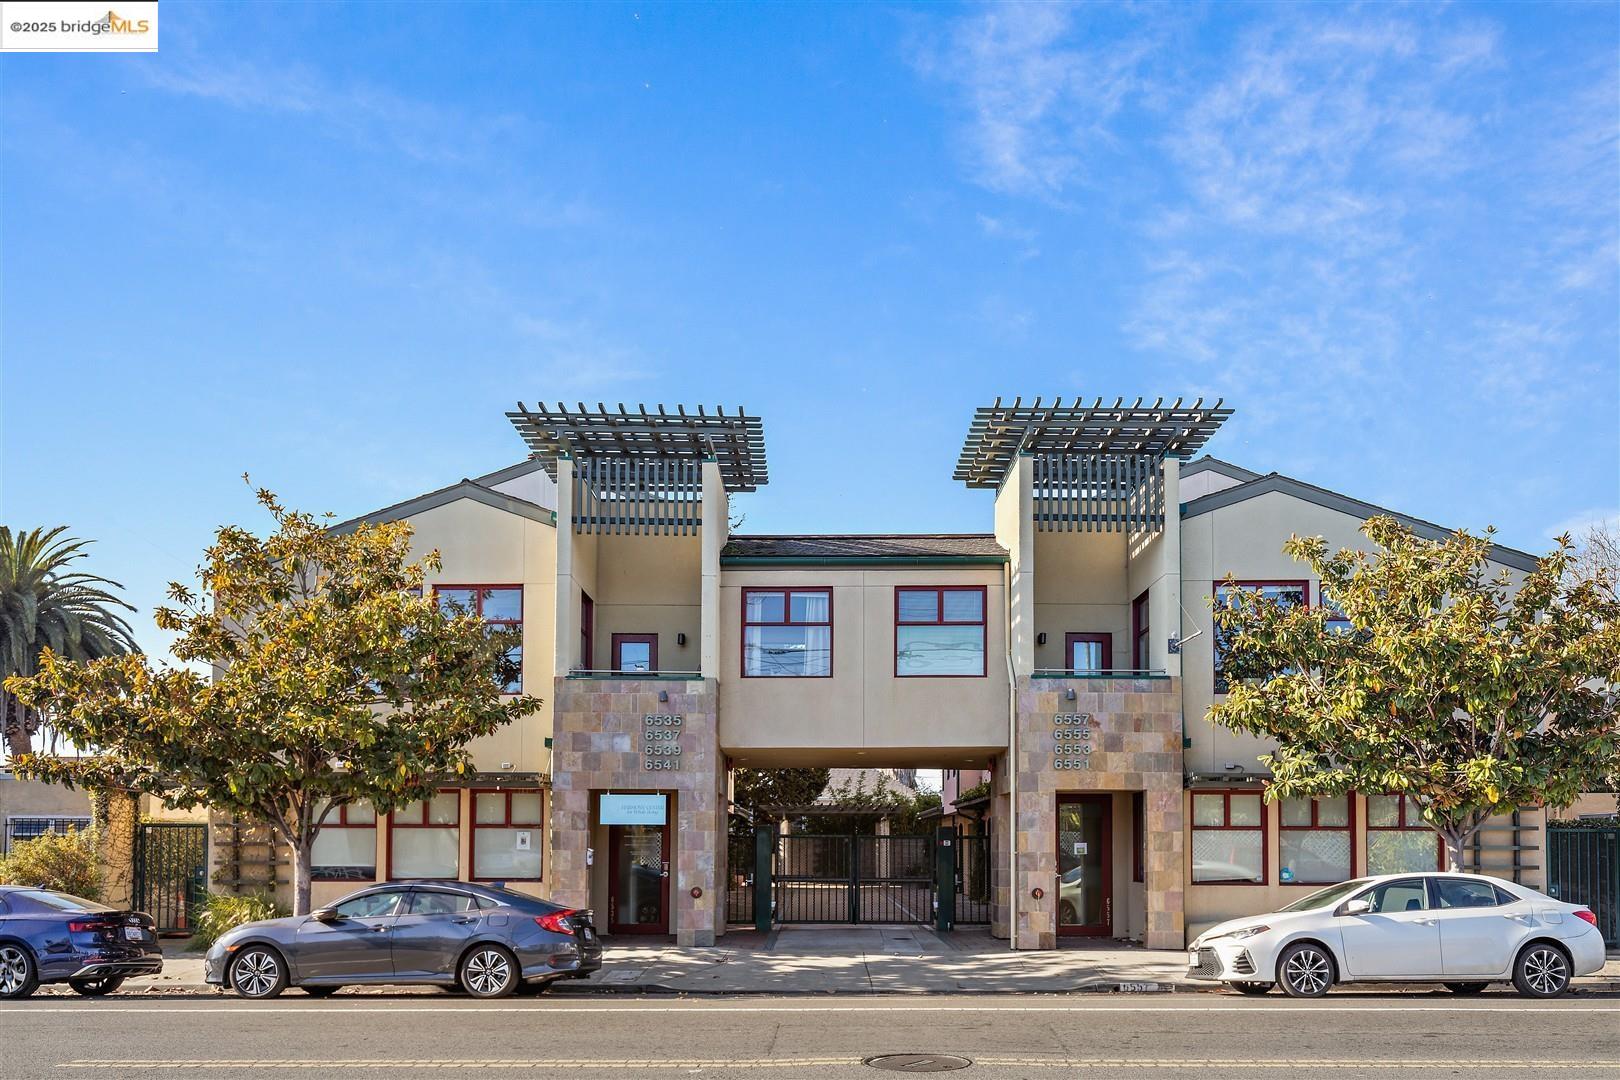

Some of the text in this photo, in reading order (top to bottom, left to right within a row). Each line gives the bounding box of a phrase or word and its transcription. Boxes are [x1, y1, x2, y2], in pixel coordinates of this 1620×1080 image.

[645, 715, 682, 726] 6535
[1054, 714, 1090, 725] 6557
[645, 730, 681, 741] 6537
[1054, 729, 1090, 740] 6555
[645, 745, 682, 756] 6539
[1054, 744, 1091, 755] 6553
[645, 760, 680, 771] 6541
[1054, 759, 1089, 770] 6551
